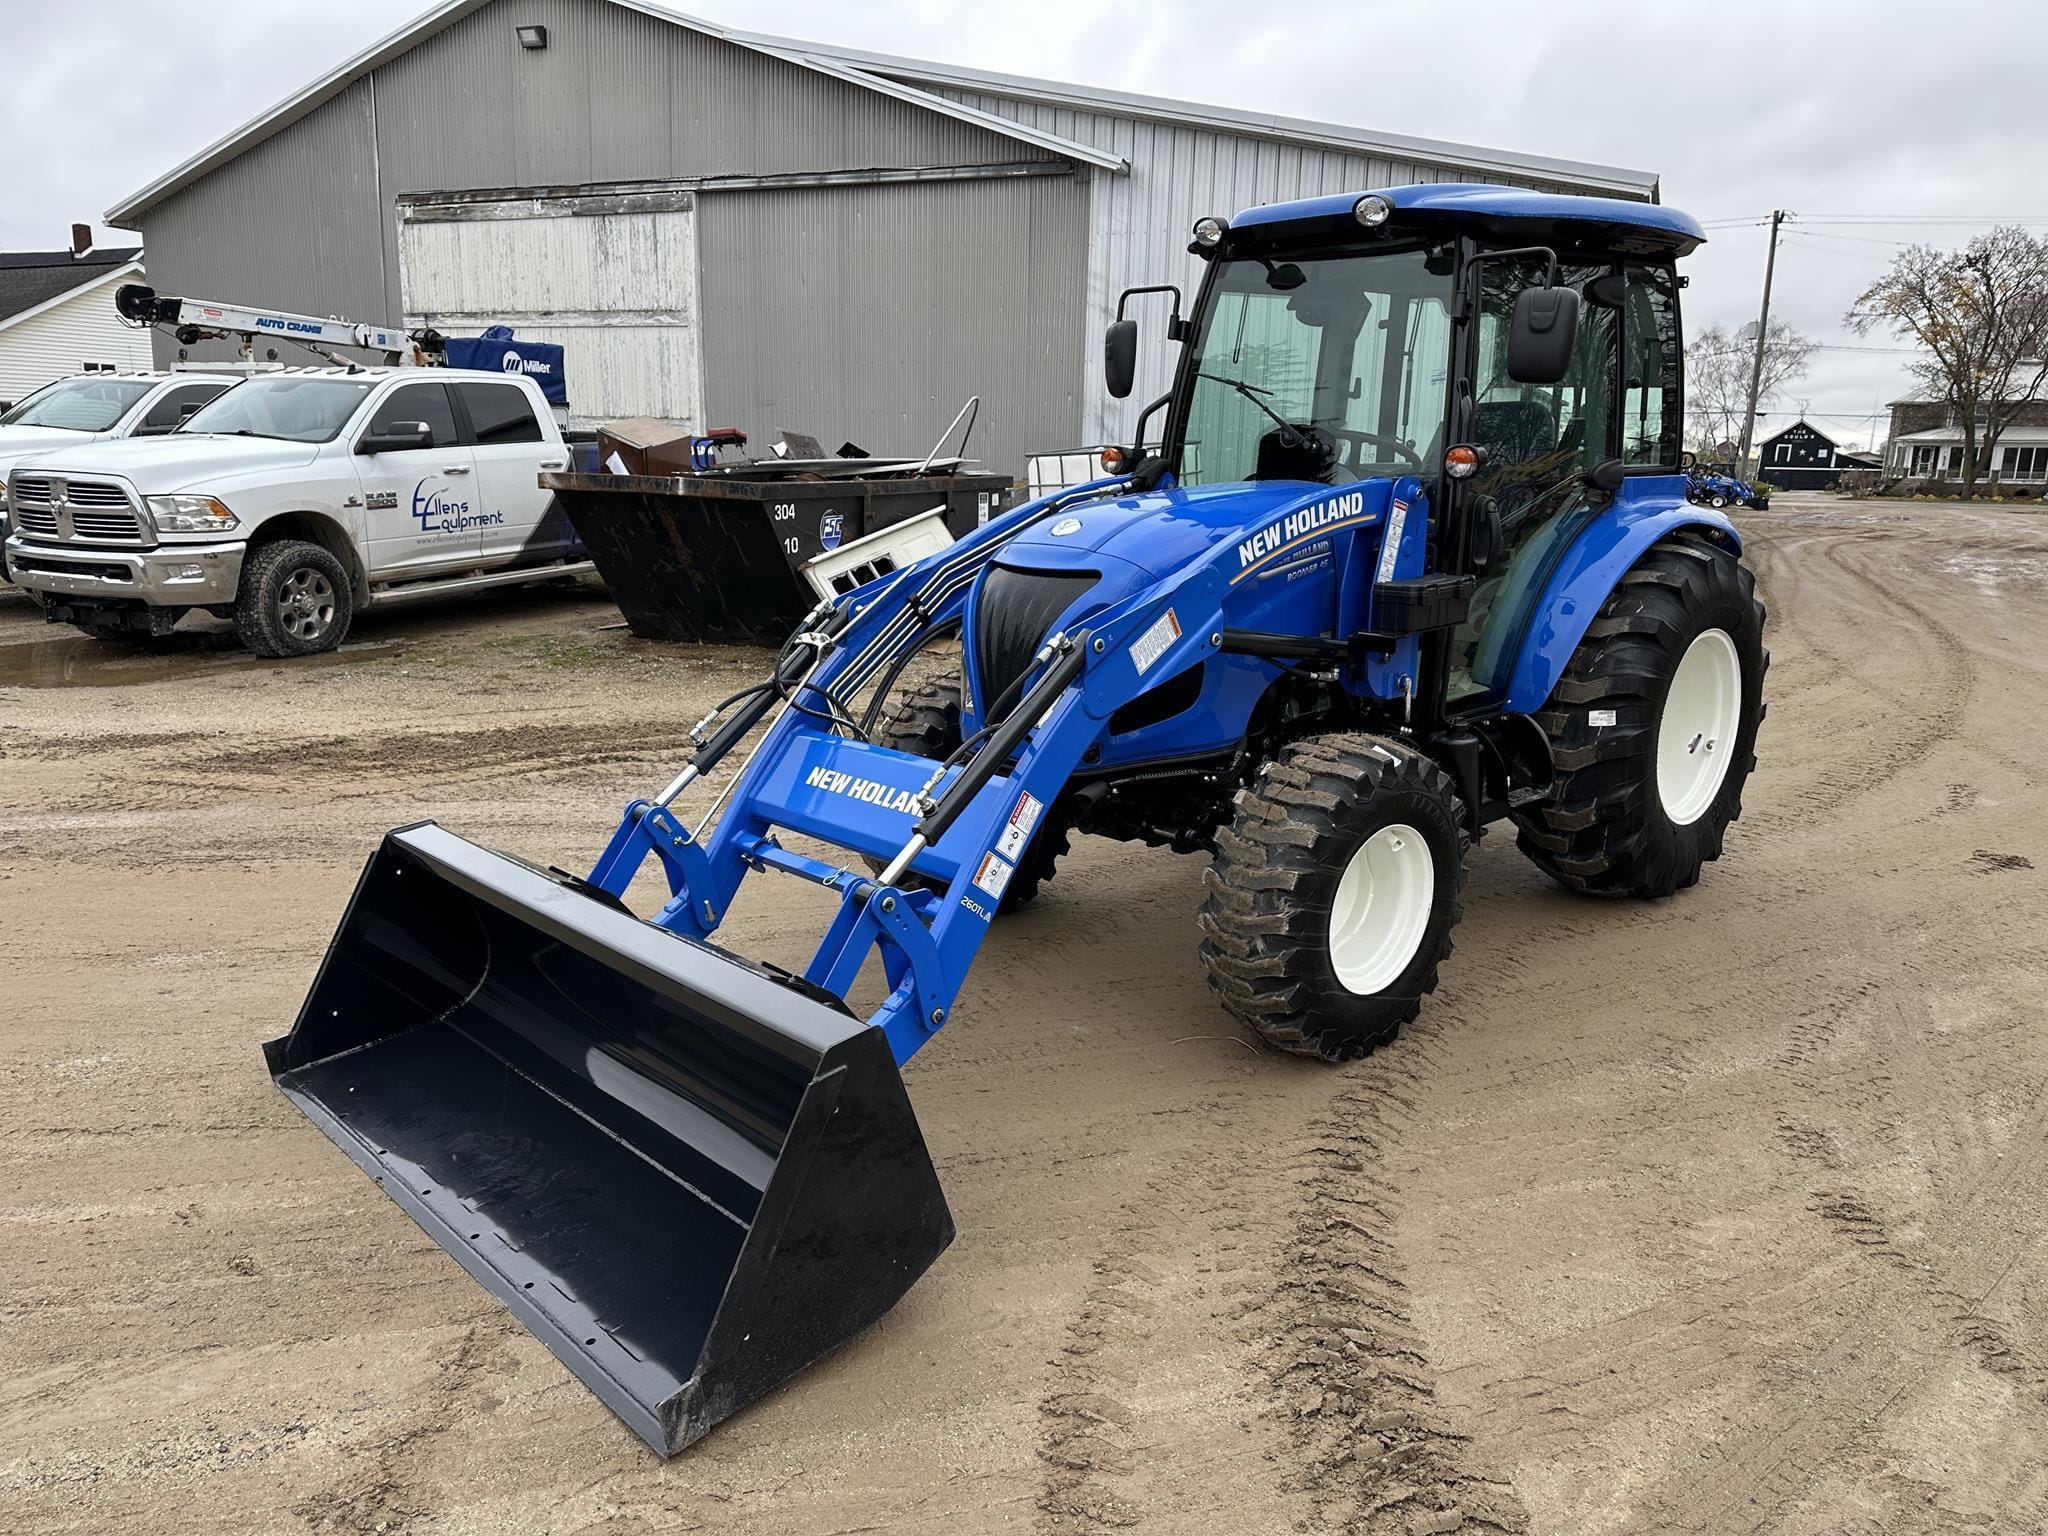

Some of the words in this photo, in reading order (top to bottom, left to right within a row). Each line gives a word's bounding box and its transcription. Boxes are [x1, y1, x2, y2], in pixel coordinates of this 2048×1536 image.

[255, 317, 285, 330] AUTO
[286, 321, 322, 334] CRANE
[523, 359, 551, 374] Miller
[365, 491, 397, 500] RAM
[412, 475, 469, 518] Ellens
[421, 486, 504, 534] Equipment
[774, 503, 796, 521] 304
[1238, 522, 1281, 568] NEW
[1284, 492, 1363, 541] HOLLAND
[784, 537, 799, 554] 10
[805, 765, 853, 794] NEW
[847, 777, 937, 819] HOLLAN
[960, 895, 992, 923] 260TLA
